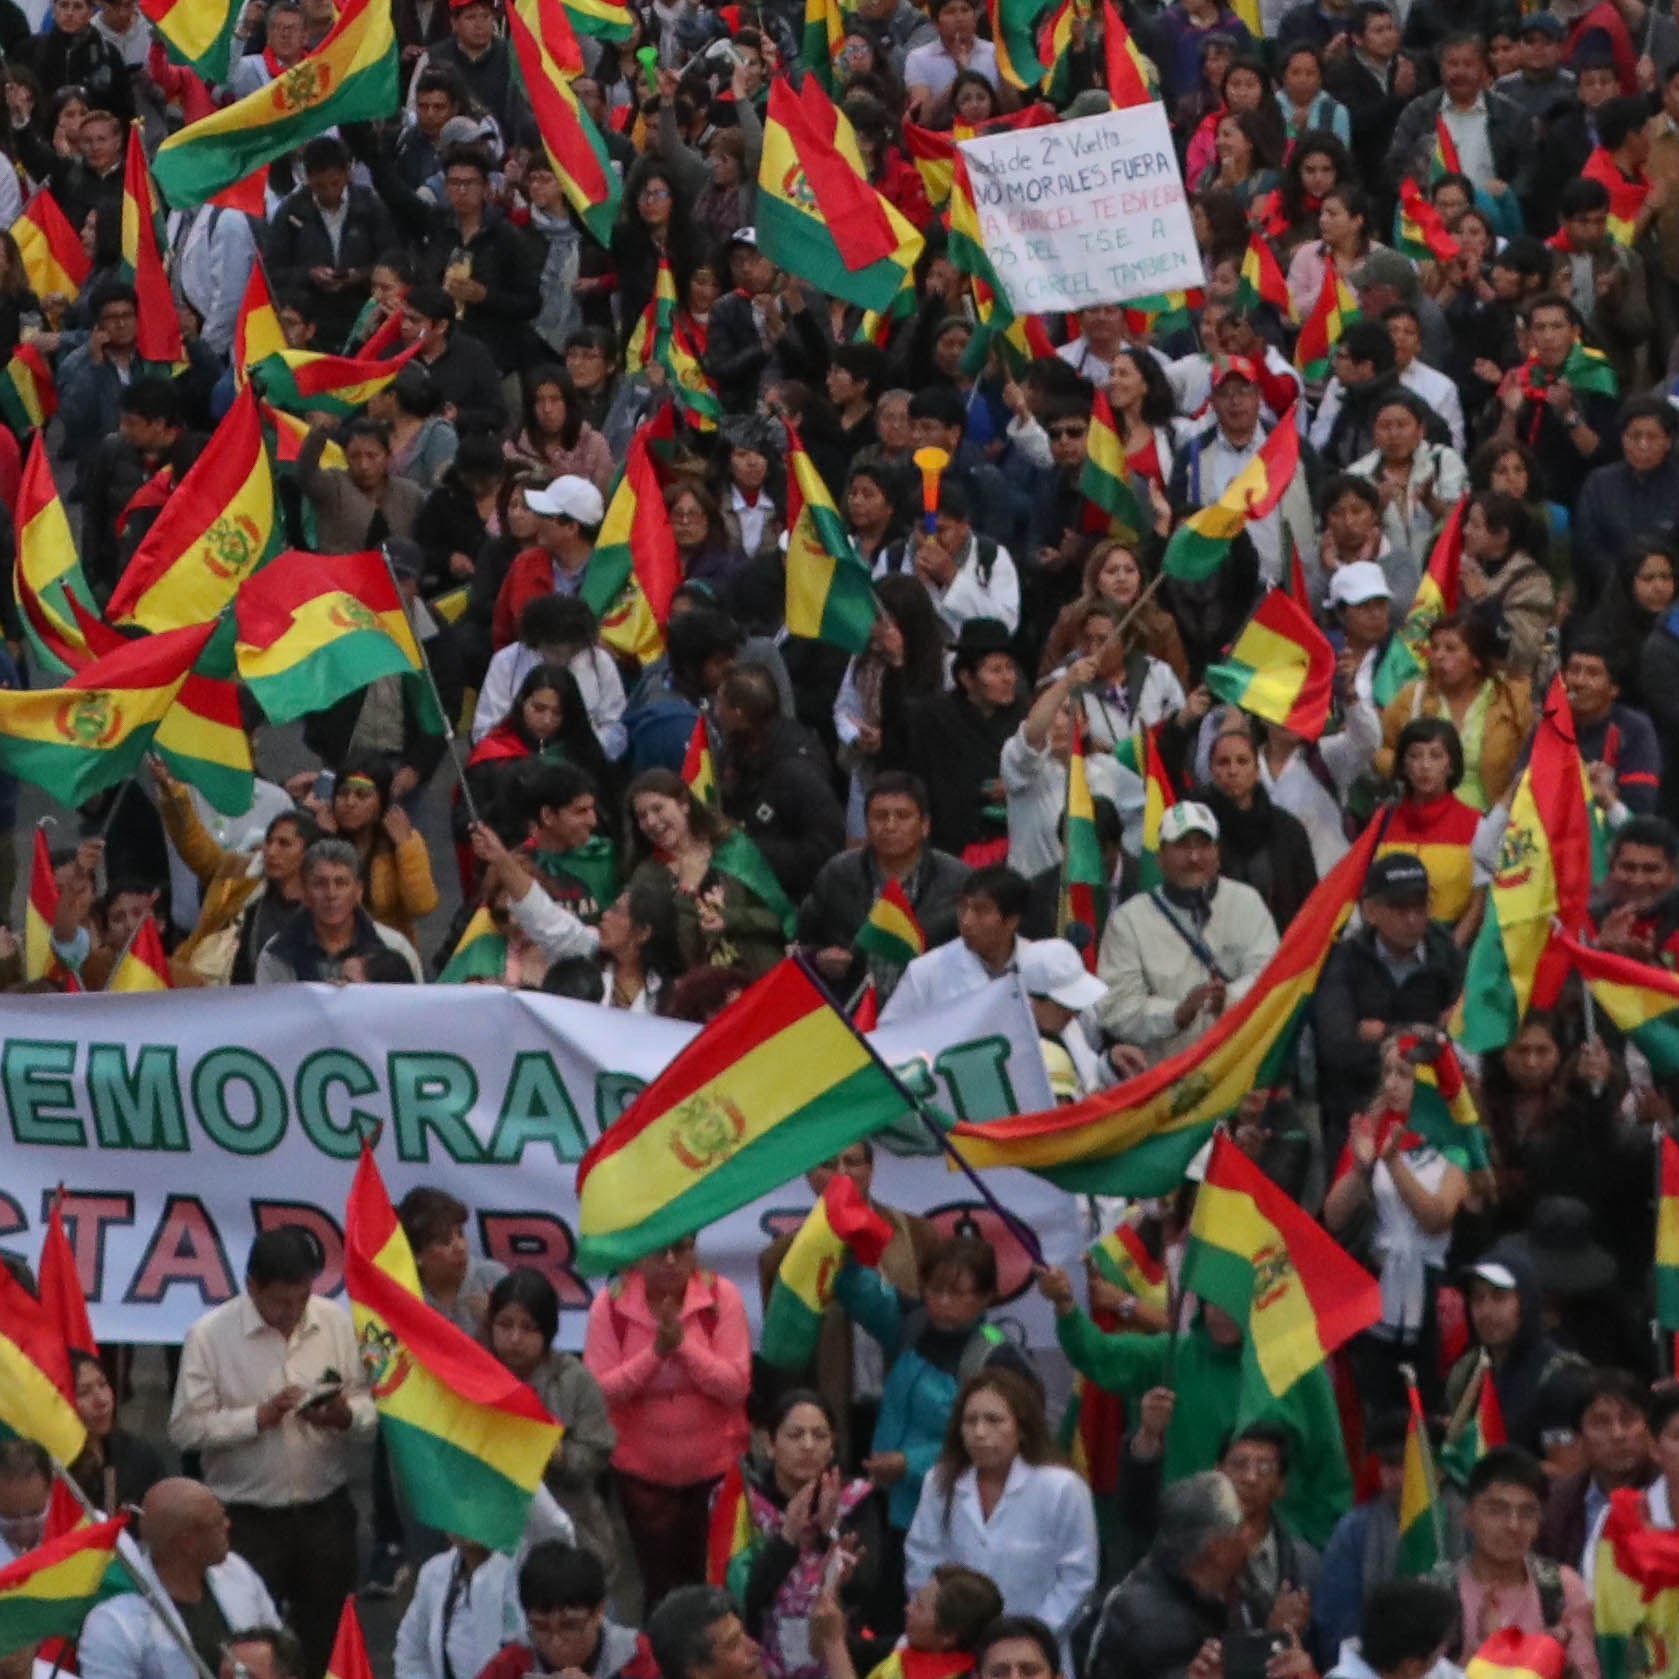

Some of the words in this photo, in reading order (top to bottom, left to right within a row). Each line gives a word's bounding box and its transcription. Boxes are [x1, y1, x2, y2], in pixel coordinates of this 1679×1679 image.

[1006, 163, 1107, 202] MORALES
[1111, 152, 1170, 184] FUERA
[1088, 196, 1117, 220] TE
[989, 243, 1017, 269] OS
[1078, 227, 1132, 253] TSE
[1151, 217, 1166, 240] A
